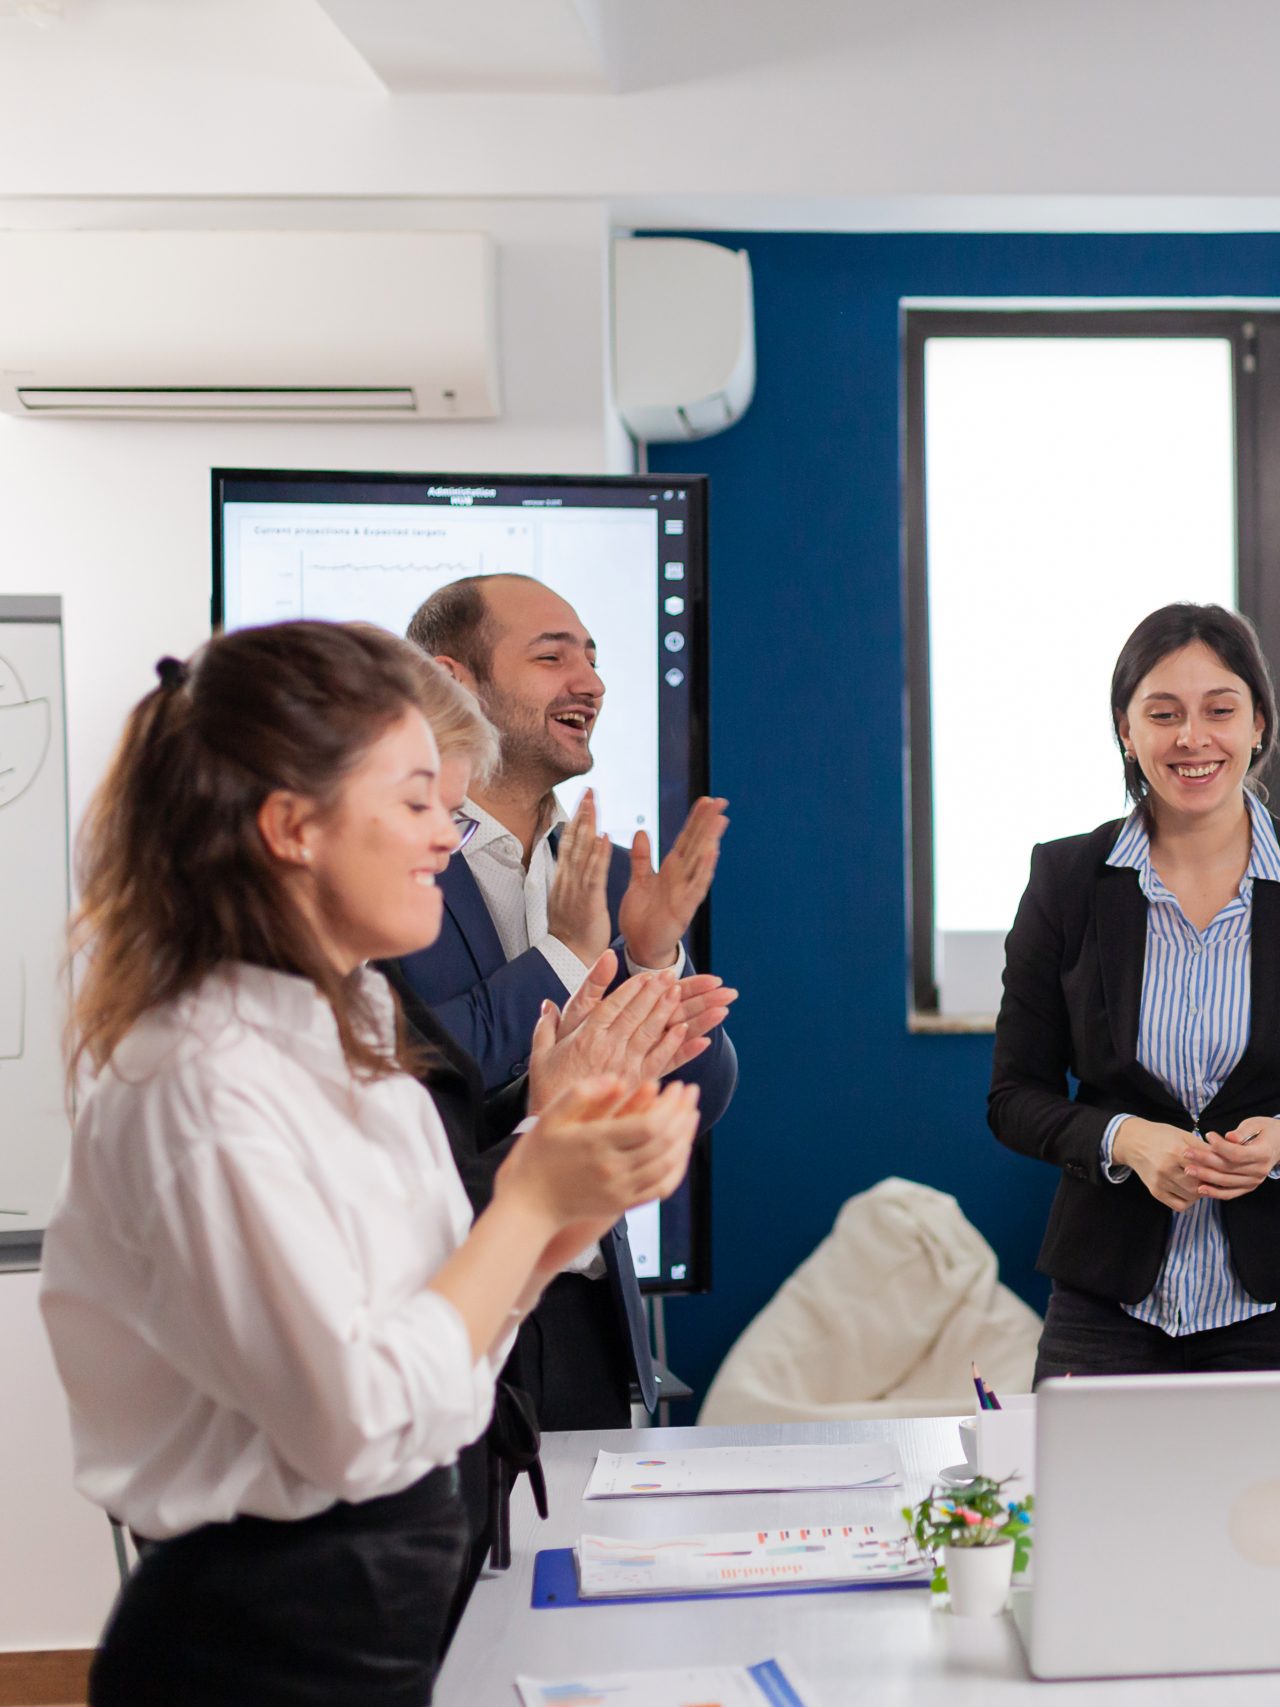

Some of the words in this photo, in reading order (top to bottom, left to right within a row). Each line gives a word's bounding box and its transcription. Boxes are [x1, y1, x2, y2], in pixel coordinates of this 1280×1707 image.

[254, 526, 291, 536] Current
[294, 526, 350, 538] projections
[363, 527, 408, 538] Expected
[412, 528, 447, 539] targets
